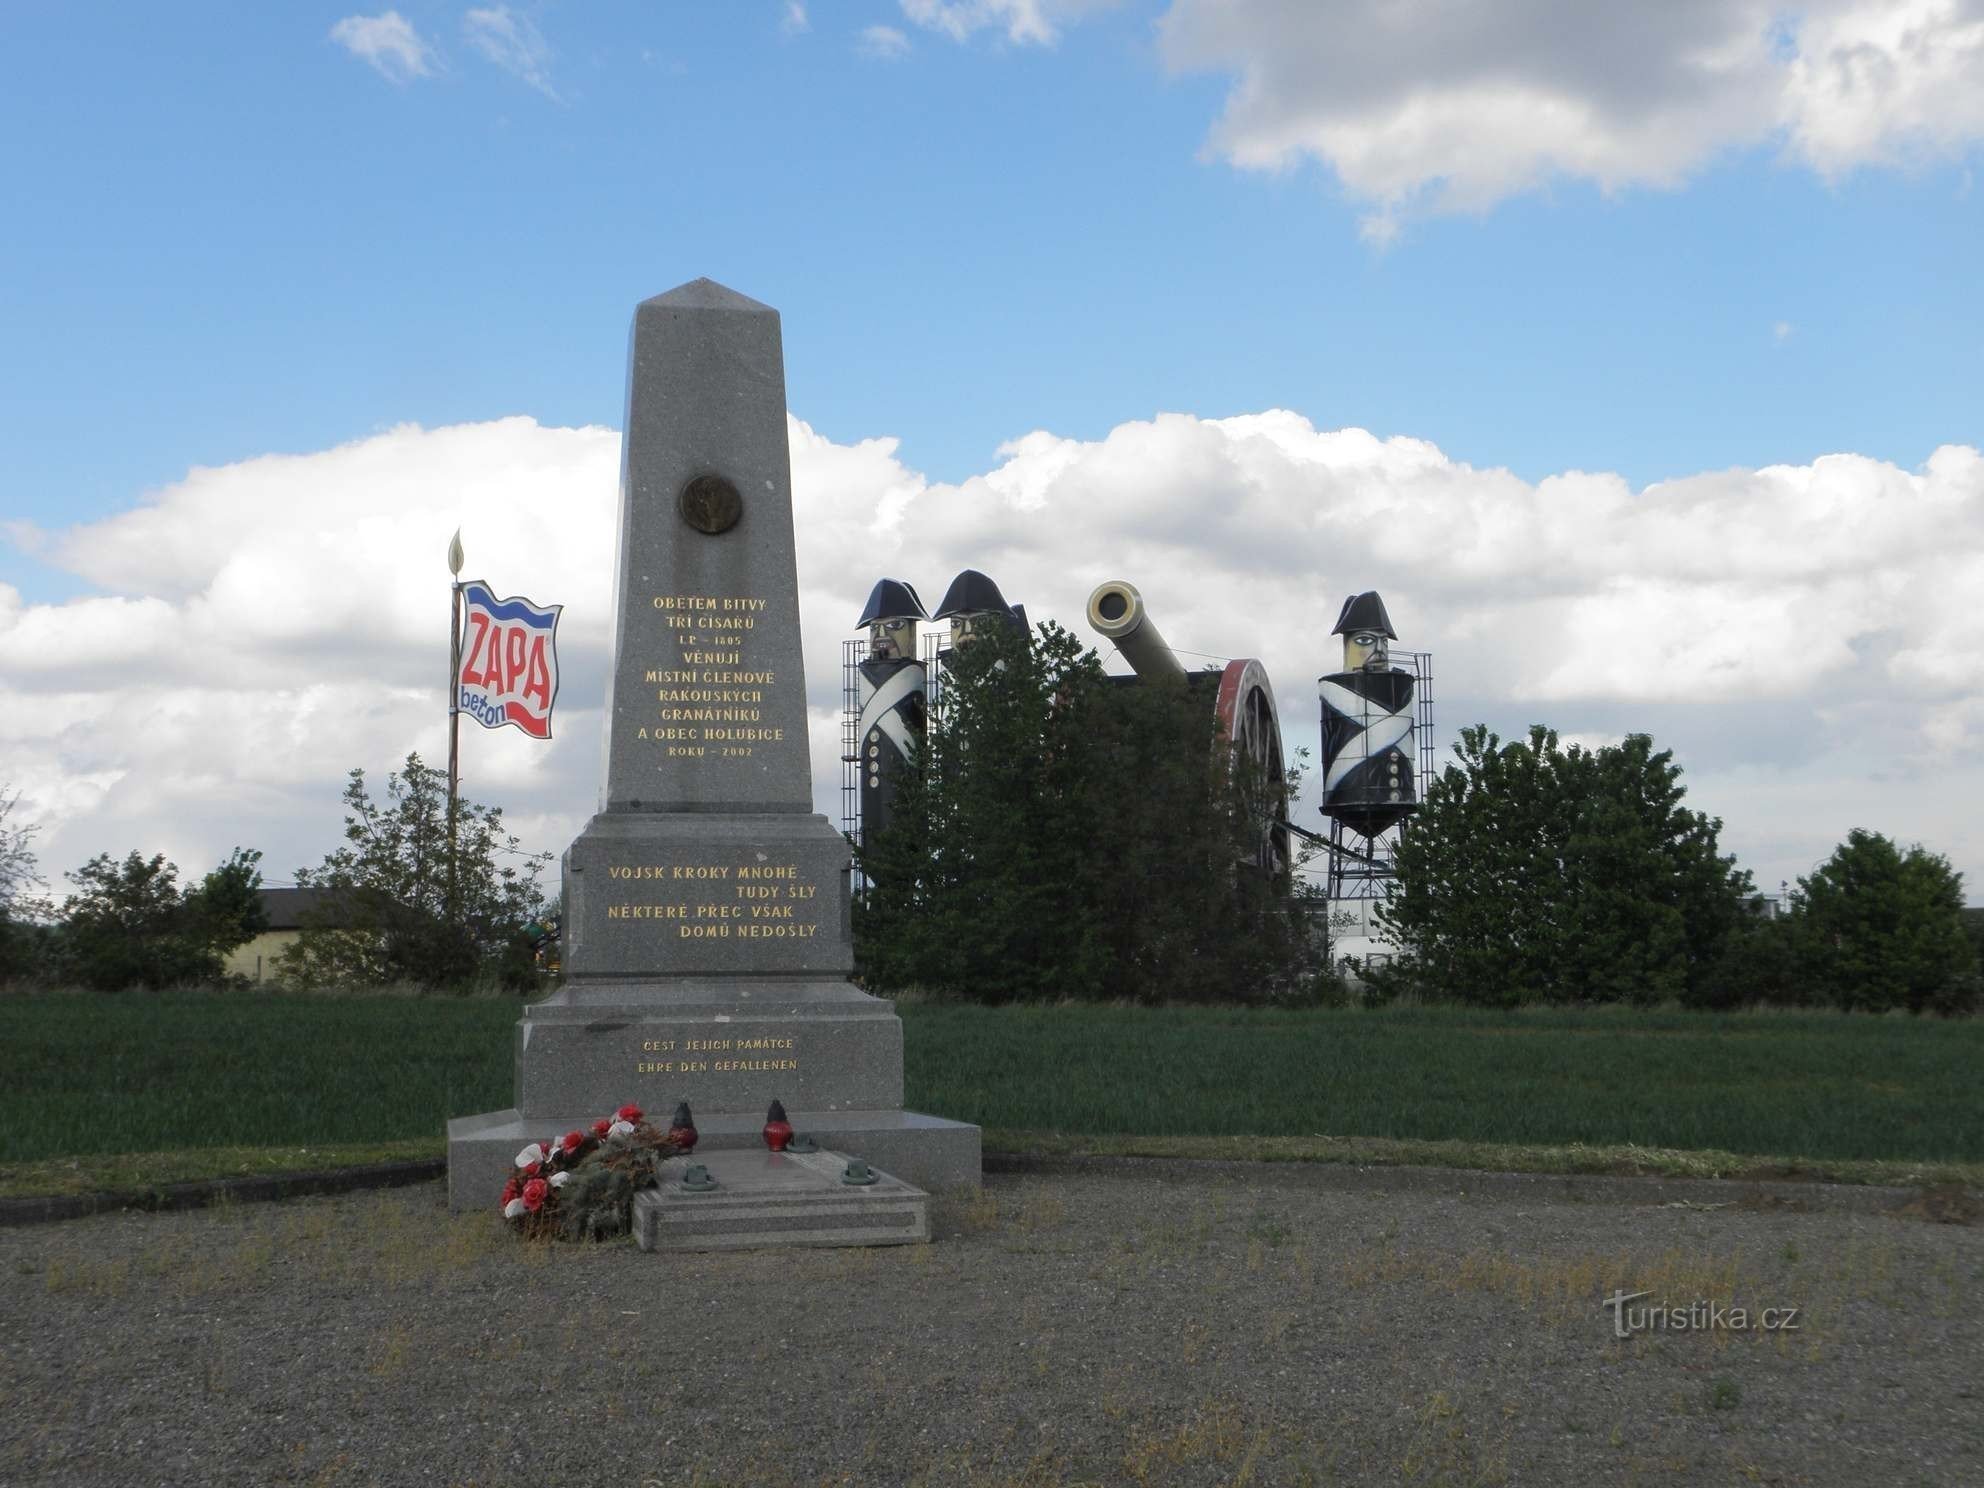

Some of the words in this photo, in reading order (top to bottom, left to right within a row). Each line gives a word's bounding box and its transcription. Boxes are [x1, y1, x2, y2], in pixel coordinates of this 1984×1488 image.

[724, 598, 766, 611] BITVY
[462, 612, 550, 711] ZAPA
[461, 686, 506, 726] beton
[638, 728, 647, 739] A
[655, 728, 697, 740] OBEC
[704, 728, 784, 741] HOLUBICE
[668, 746, 705, 757] ROKU
[722, 747, 753, 757] 2002
[609, 866, 664, 879] VOJSK
[674, 866, 728, 879] KROKY
[738, 864, 798, 879] MNOHÉ
[736, 886, 779, 898] TUDY
[685, 1039, 730, 1051] JEJICH
[638, 1062, 673, 1073] EHRE
[680, 1061, 707, 1073] DEN
[714, 1060, 798, 1072] GEFALLENEN
